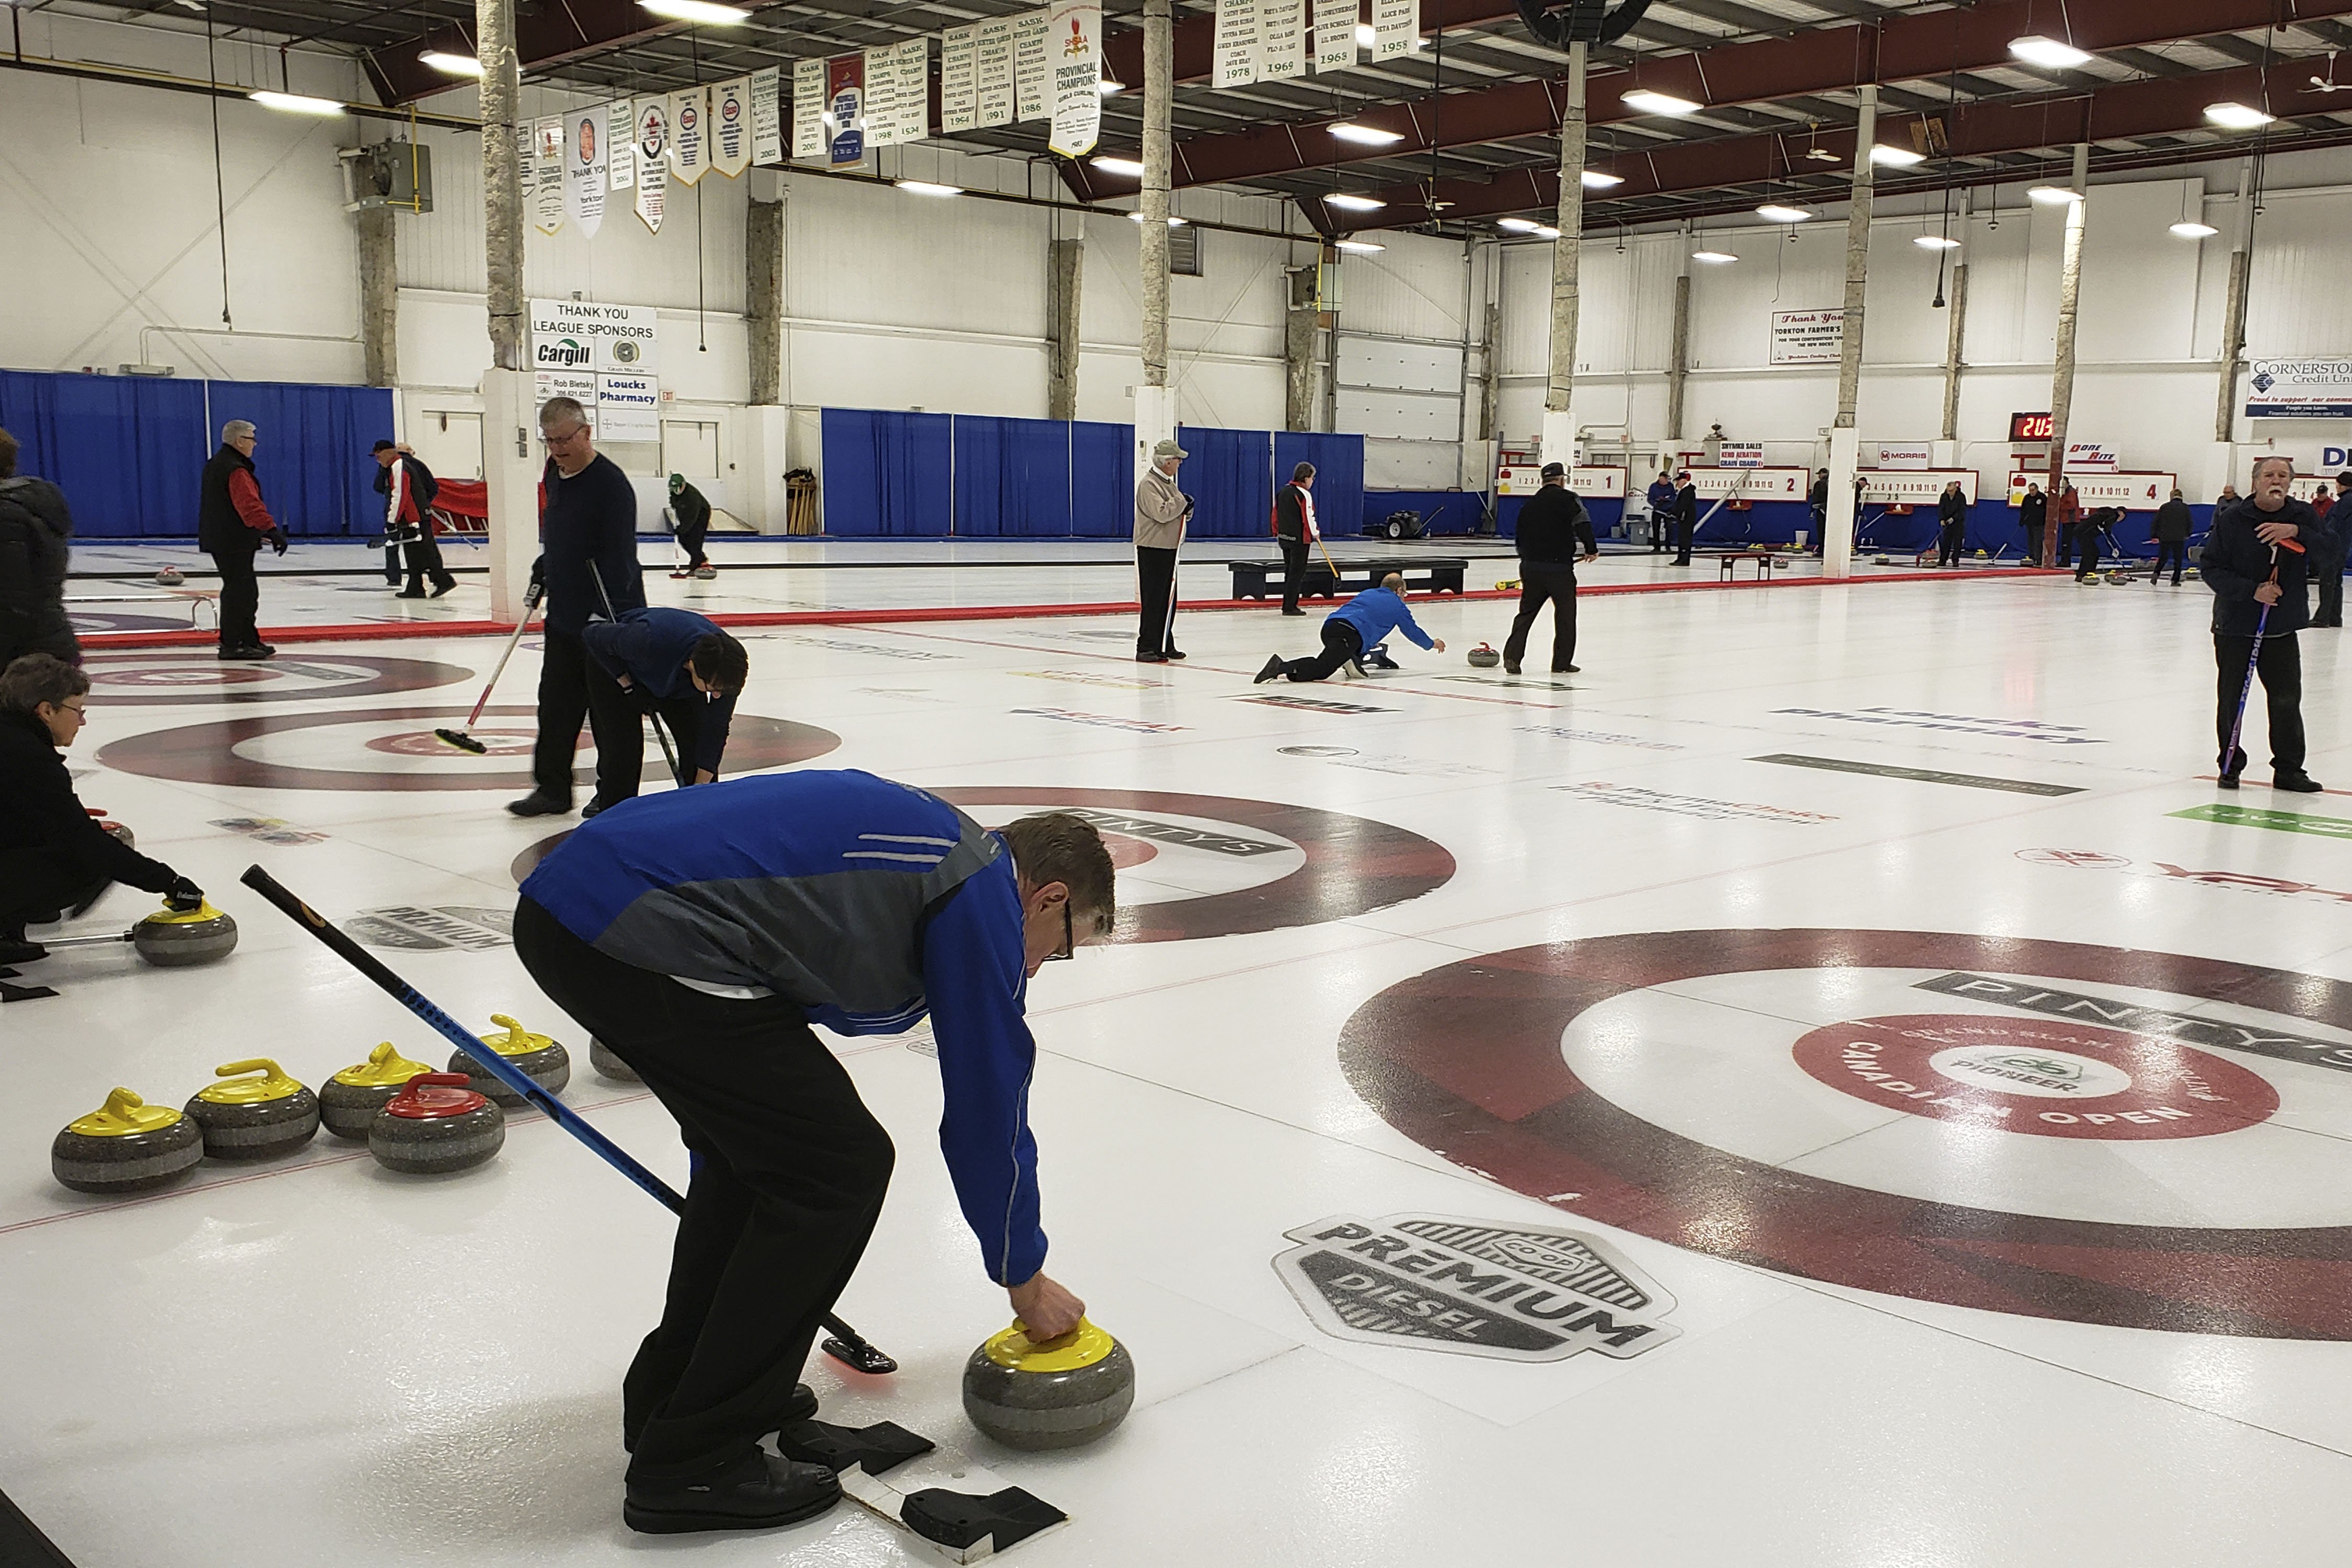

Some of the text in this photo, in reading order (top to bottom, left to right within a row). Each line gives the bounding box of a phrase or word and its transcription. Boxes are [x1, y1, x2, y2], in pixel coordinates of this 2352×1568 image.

[1018, 17, 1043, 27] SASK
[983, 25, 1007, 34] SASK
[948, 32, 970, 41] SASK
[871, 51, 890, 60] SASK
[902, 45, 923, 54] SASK
[1056, 62, 1097, 79] PROVINCIAL
[1226, 68, 1250, 79] 1978
[1267, 61, 1294, 73] 1969
[870, 71, 891, 80] CHAMPS
[1057, 74, 1096, 91] CHAMPIONS
[1058, 93, 1072, 103] GIRLS
[1021, 103, 1041, 114] 1986
[986, 111, 1005, 121] 1991
[875, 132, 892, 140] 1998
[760, 149, 776, 158] 2002
[571, 167, 592, 178] THANK
[558, 305, 628, 319] THANK YOU
[1782, 314, 1843, 324] Thank You
[534, 321, 653, 338] LEAGUE SPONSORS
[538, 344, 590, 366] Cargill
[2254, 361, 2352, 375] CORNERSTO
[608, 379, 646, 389] Loucks
[600, 392, 655, 405] Pharmacy
[1606, 476, 1611, 489] 1
[1786, 478, 1794, 491] 2
[2147, 485, 2157, 499] 4
[1768, 708, 2109, 744] Pharmacy
[1857, 707, 2088, 732] Loucks
[1577, 797, 1737, 821] Pharmacy
[1615, 787, 1840, 821] PharmaChoice
[1067, 811, 1266, 853] PINTY'S
[375, 907, 513, 949] PREMIUM
[1954, 978, 2352, 1066] PINTY'S
[1950, 1058, 2082, 1092] PIONEER
[1841, 1040, 2193, 1125] CANADIAN OPEN
[1313, 1222, 1656, 1347] PREMIUM
[1328, 1273, 1489, 1338] DIESEL
